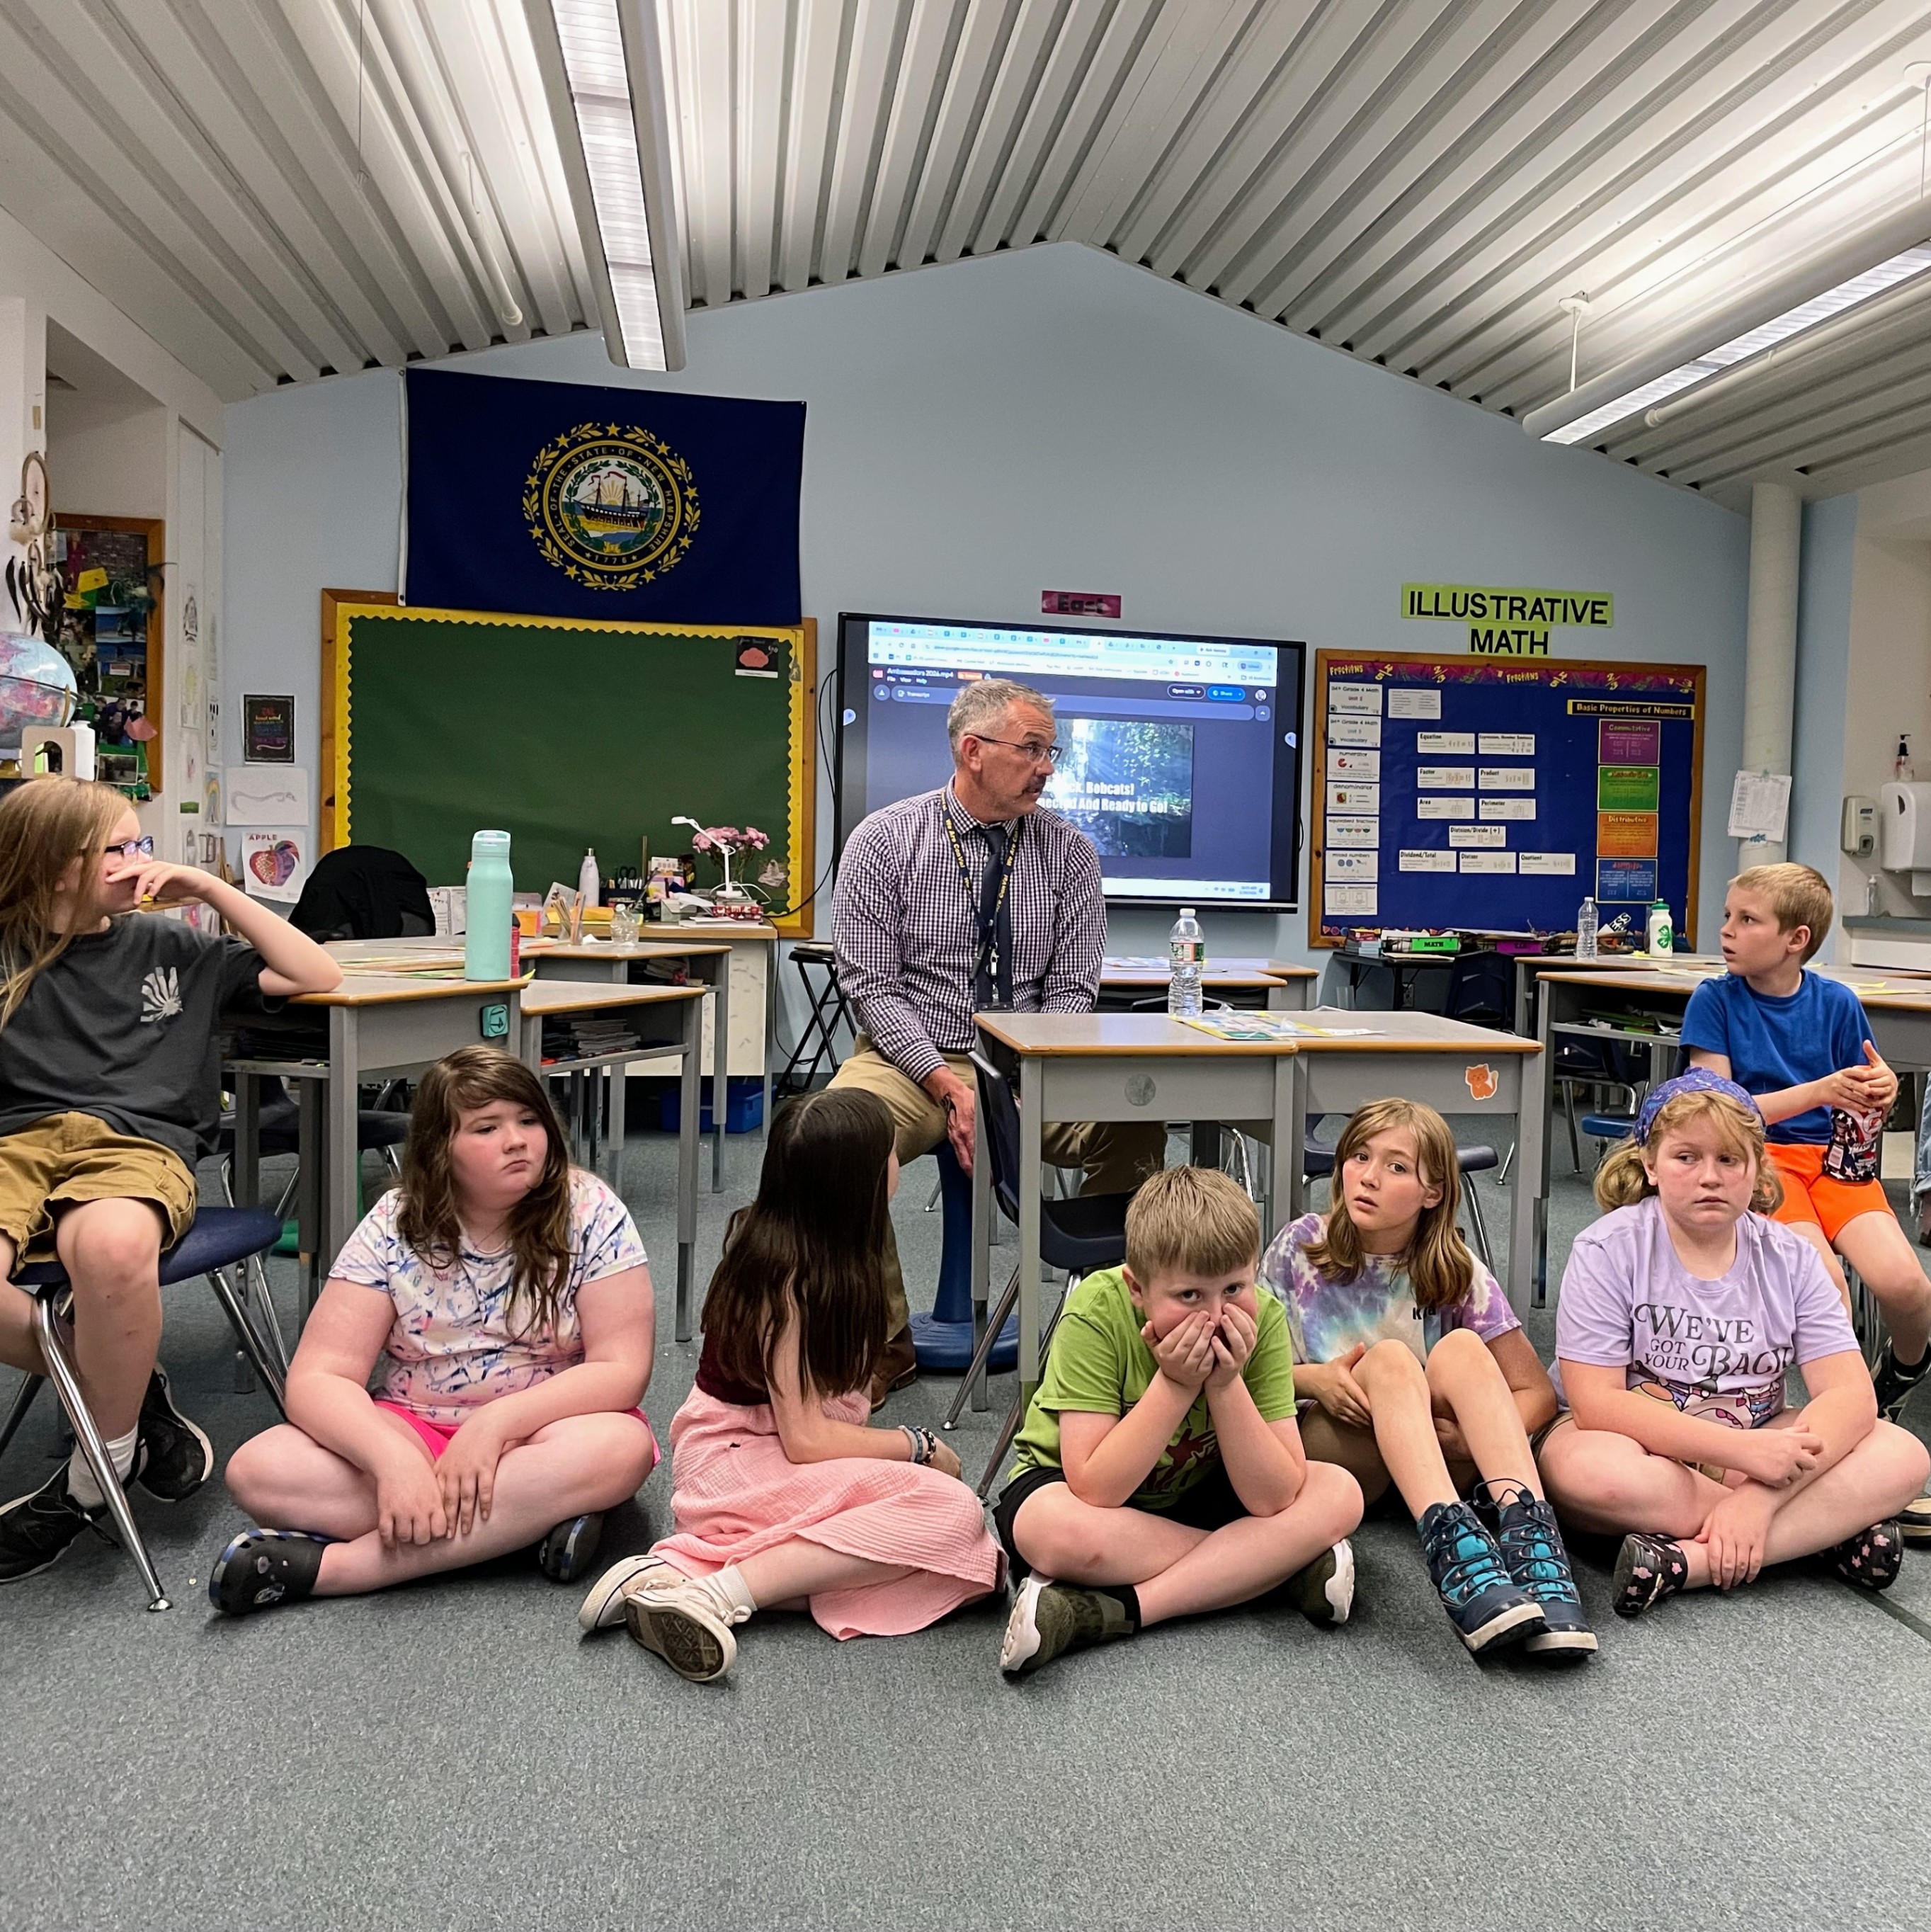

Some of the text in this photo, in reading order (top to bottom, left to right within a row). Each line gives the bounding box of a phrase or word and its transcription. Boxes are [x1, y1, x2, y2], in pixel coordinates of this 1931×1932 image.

[549, 447, 675, 552] SEAL OF THE STATE OF NEW HAMPSHIRE
[594, 555, 627, 564] 1776
[1410, 591, 1608, 625] ILLUSTRATIVE
[1470, 628, 1549, 655] MATH
[887, 668, 925, 676] Ambassadors
[1576, 703, 1597, 712] Basic
[1600, 704, 1640, 714] Properties
[1653, 707, 1687, 716] Numbers
[1086, 781, 1134, 796] Bobcats!
[1078, 797, 1100, 810] And
[1101, 797, 1135, 813] Ready
[1137, 800, 1148, 812] to
[1149, 800, 1168, 814] Go!
[945, 819, 966, 868] We Are ConVal
[1006, 856, 1013, 867] We
[1634, 1303, 1754, 1343] WE'VE
[1651, 1339, 1685, 1354] GOT
[1644, 1353, 1690, 1371] YOUR
